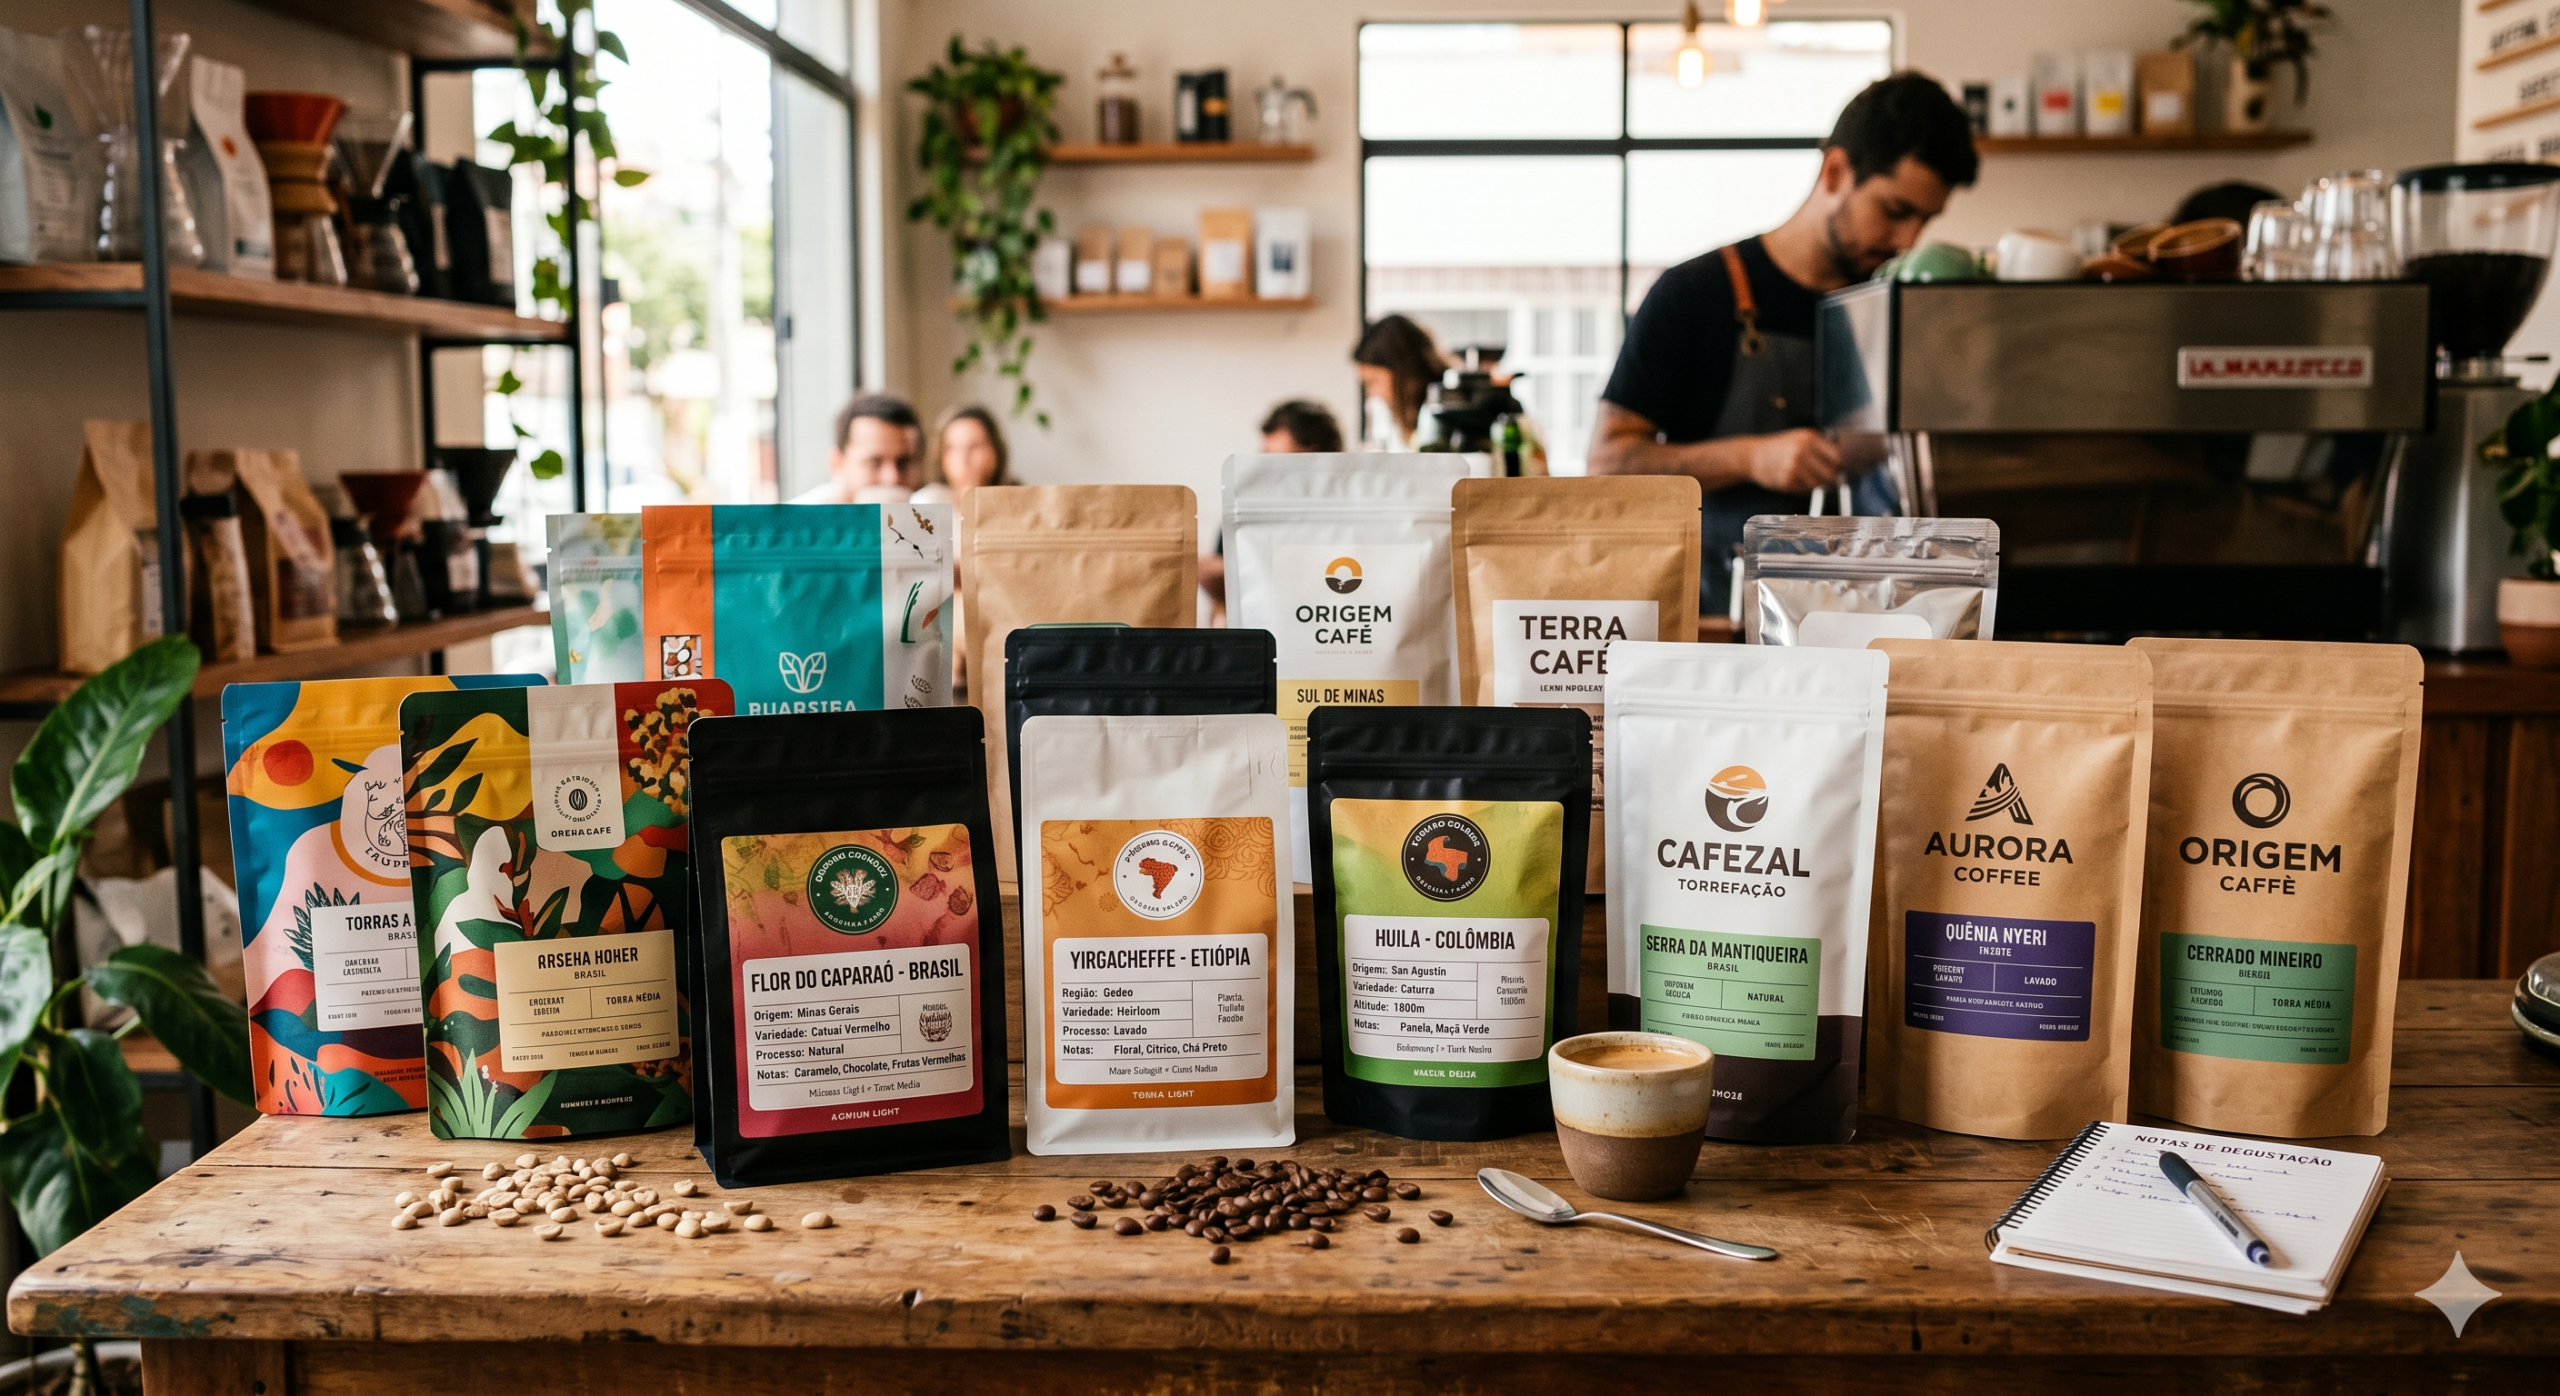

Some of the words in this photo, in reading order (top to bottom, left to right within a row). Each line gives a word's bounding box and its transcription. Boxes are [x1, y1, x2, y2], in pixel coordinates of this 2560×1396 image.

[1296, 605, 1392, 622] ORIGEM
[1519, 616, 1627, 640] TERRA
[1297, 689, 1320, 703] SUL
[1324, 689, 1339, 703] DE
[1344, 689, 1384, 703] MINAS
[1924, 831, 2073, 864] AURORA
[2179, 836, 2341, 873] ORIGEM
[1657, 838, 1810, 877] CAFEZAL
[1954, 866, 2040, 886] COFFEE
[1678, 878, 1785, 898] TORREFAÇÃO
[2220, 875, 2296, 895] CAFFÈ
[345, 914, 398, 930] TORRAS
[403, 913, 411, 927] A
[1375, 929, 1420, 948] HUILA
[1435, 928, 1515, 949] COLÔMBIA
[1946, 921, 1998, 943] QUÊNIA
[2003, 927, 2046, 946] NYERI
[1070, 949, 1176, 969] YIRGACHEFFE
[1191, 944, 1251, 966] ETIÓPIA
[1646, 935, 1685, 955] SERRA
[1690, 940, 1707, 957] DA
[1711, 941, 1808, 964] MANTIQUEIRA
[2187, 944, 2255, 965] CERRADO
[2260, 950, 2323, 969] MINEIRO
[574, 970, 606, 979] BRASIL
[751, 972, 791, 992] FLOR
[795, 969, 817, 989] DO
[821, 960, 894, 988] CAPARAÓ
[909, 958, 963, 980] BRASIL
[1391, 966, 1409, 975] San
[1707, 962, 1739, 973] BRASIL
[1352, 981, 1398, 993] Variedade:
[1400, 985, 1434, 994] Caturra
[2024, 977, 2057, 986] LAVADO
[606, 995, 633, 1005] TORRA
[1062, 988, 1098, 999] Região:
[1103, 988, 1133, 997] Gedeo
[1747, 993, 1784, 1003] NATURAL
[1062, 1007, 1113, 1016] Variedade:
[1117, 1006, 1160, 1016] Heirloom
[1354, 999, 1389, 1012] Altitude:
[1393, 1003, 1425, 1013] 1800m
[2272, 998, 2301, 1008] TORRA
[754, 1009, 793, 1022] Origem:
[797, 1007, 826, 1018] Minas
[829, 1004, 860, 1015] Gerais
[755, 1027, 808, 1040] Variedade:
[811, 1023, 843, 1037] Catuaí
[844, 1021, 890, 1034] Vermelho
[1063, 1026, 1110, 1036] Processo:
[1113, 1025, 1147, 1035] Lavado
[1354, 1019, 1380, 1030] Notas:
[1400, 1022, 1433, 1034] Panela,
[1436, 1023, 1460, 1035] Maçã
[1463, 1024, 1490, 1034] Verde
[756, 1048, 805, 1060] Processo:
[808, 1044, 844, 1057] Natural
[1063, 1045, 1094, 1054] Notas:
[1114, 1045, 1144, 1055] Floral,
[1182, 1043, 1200, 1053] Chá
[1202, 1042, 1228, 1052] Preto
[757, 1069, 789, 1080] Notas:
[794, 1064, 841, 1078] Caramelo,
[843, 1061, 890, 1074] Chocolate,
[892, 1057, 920, 1069] Frutas
[922, 1053, 966, 1066] Vermelhas
[873, 1108, 900, 1117] LIGHT
[2134, 1134, 2190, 1148] NOTAS
[2194, 1142, 2216, 1152] DE
[2220, 1146, 2333, 1166] DEGUSTAÇÃO
